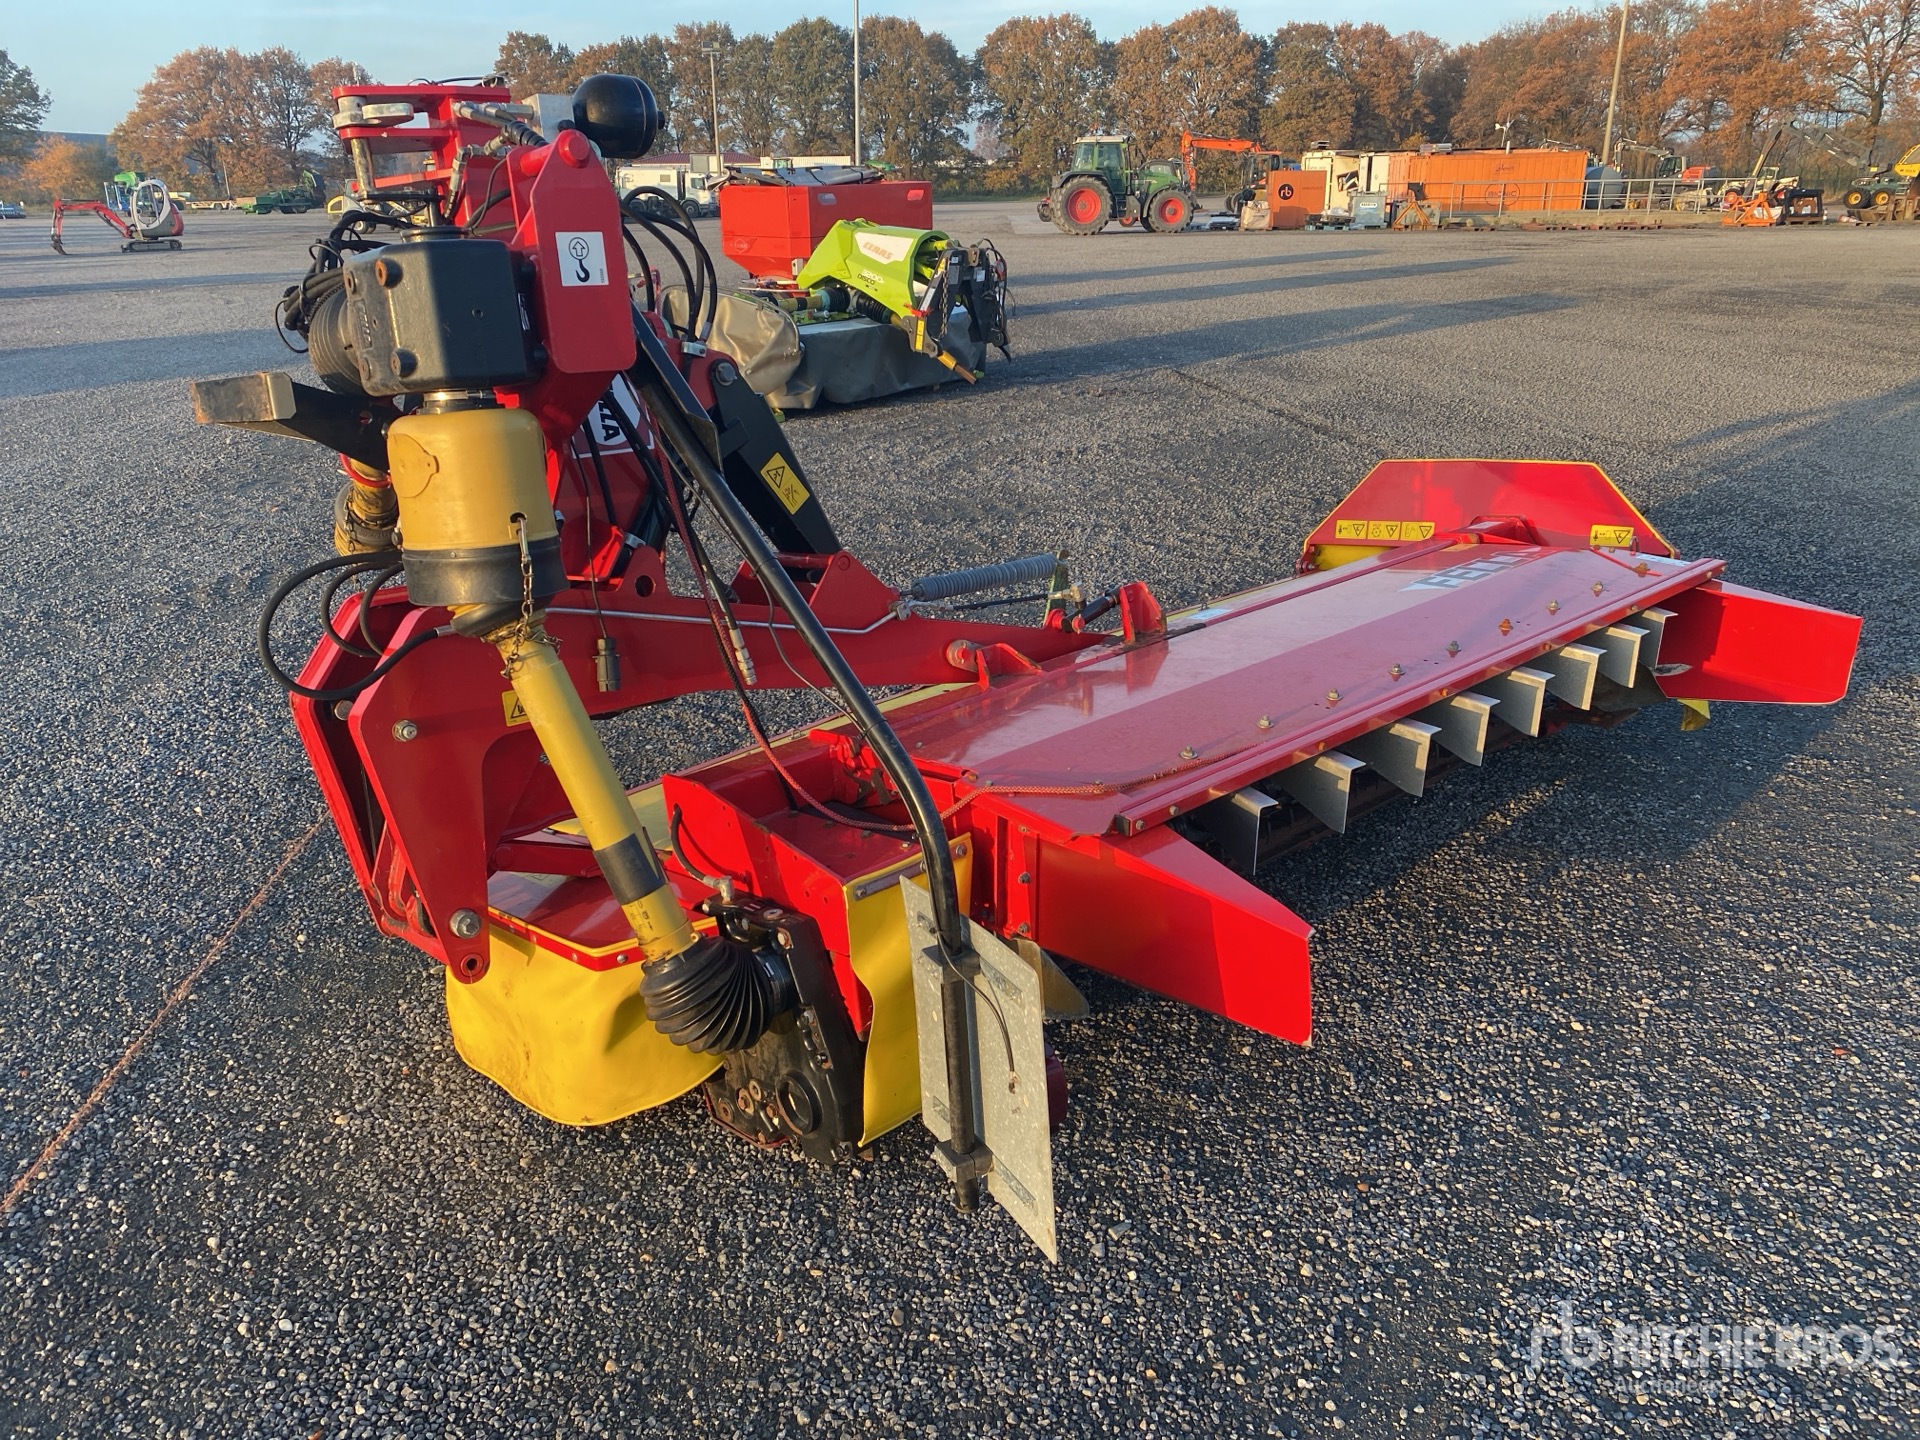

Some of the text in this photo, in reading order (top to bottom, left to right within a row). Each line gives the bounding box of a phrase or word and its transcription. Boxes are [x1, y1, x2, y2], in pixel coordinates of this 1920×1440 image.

[1280, 186, 1292, 197] rb
[862, 241, 894, 260] CLAAS
[857, 273, 876, 285] DISCO
